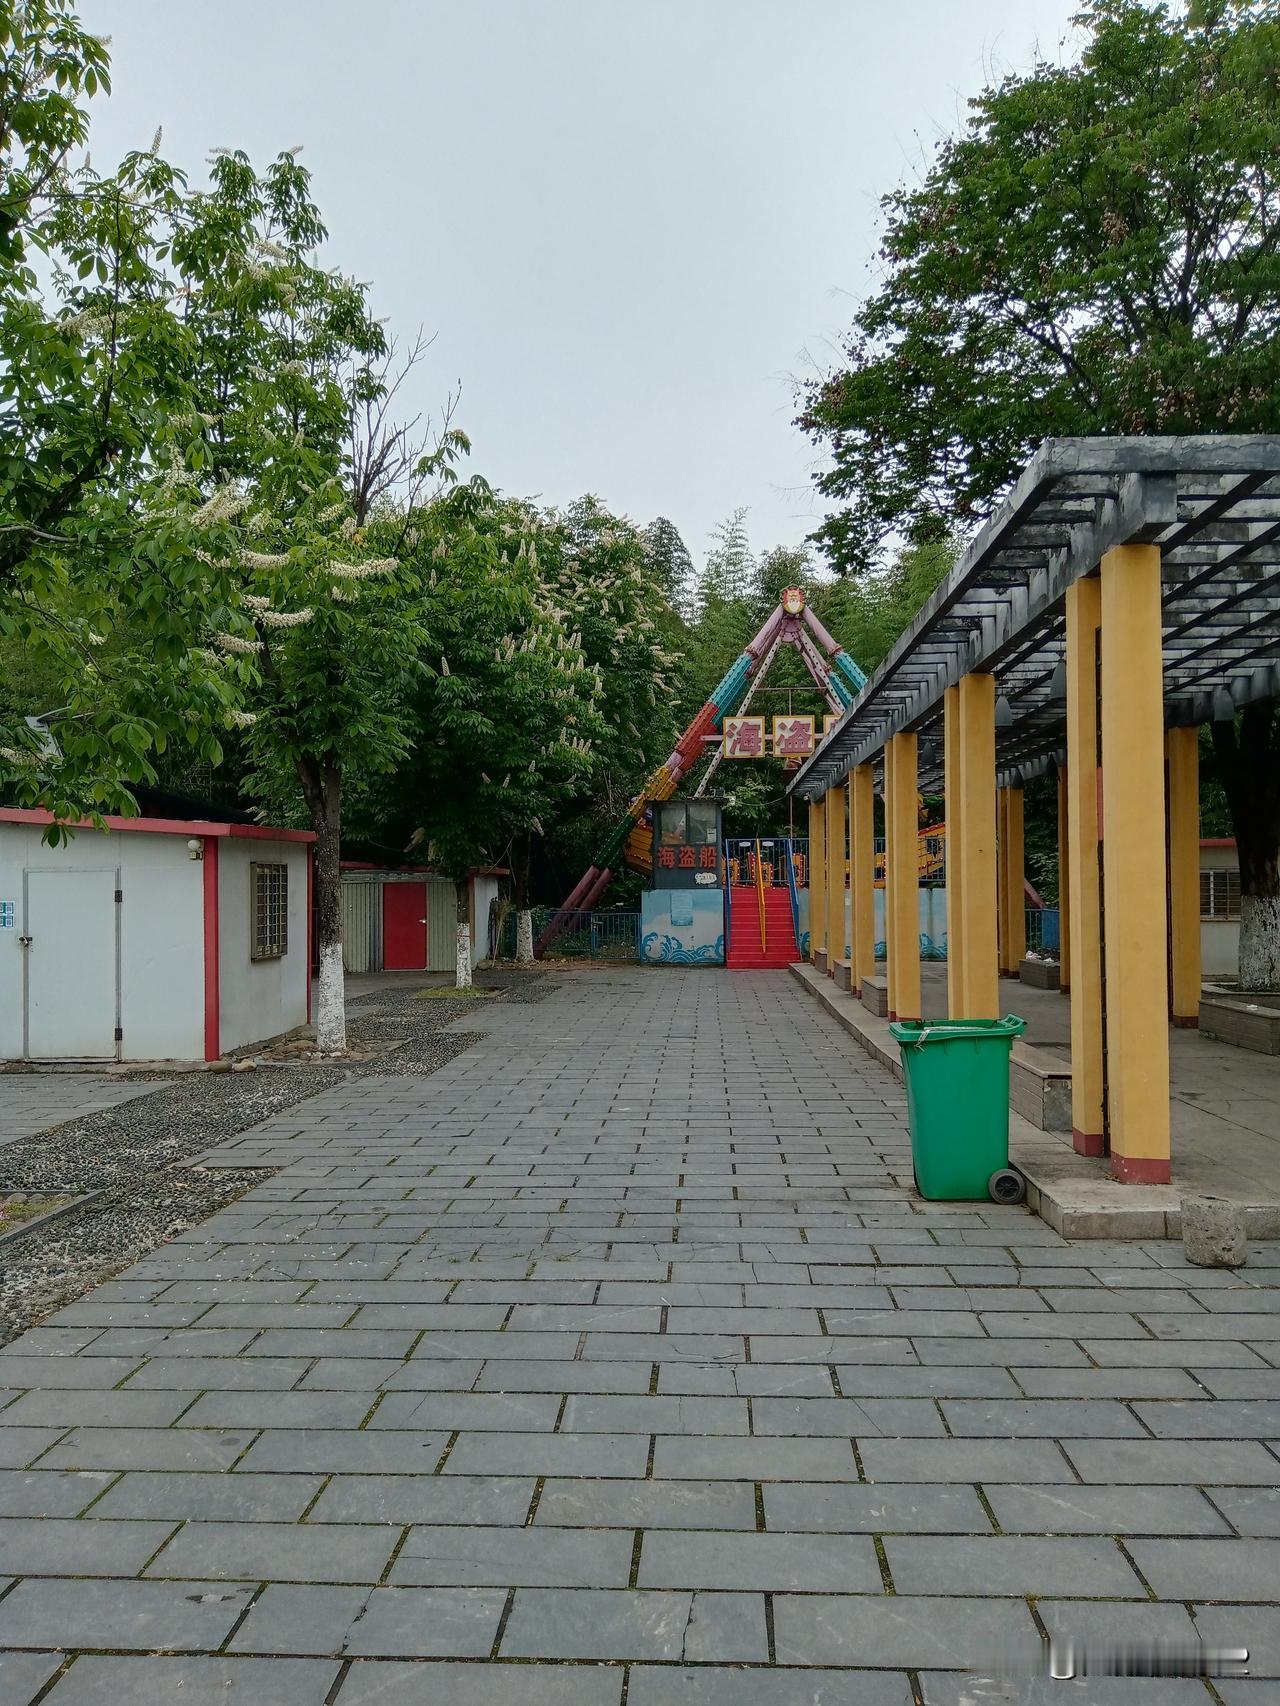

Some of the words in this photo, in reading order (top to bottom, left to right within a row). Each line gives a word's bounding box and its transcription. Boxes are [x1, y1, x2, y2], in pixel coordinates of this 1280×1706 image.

[725, 720, 840, 756] 海盗
[657, 846, 717, 869] 海盗船
